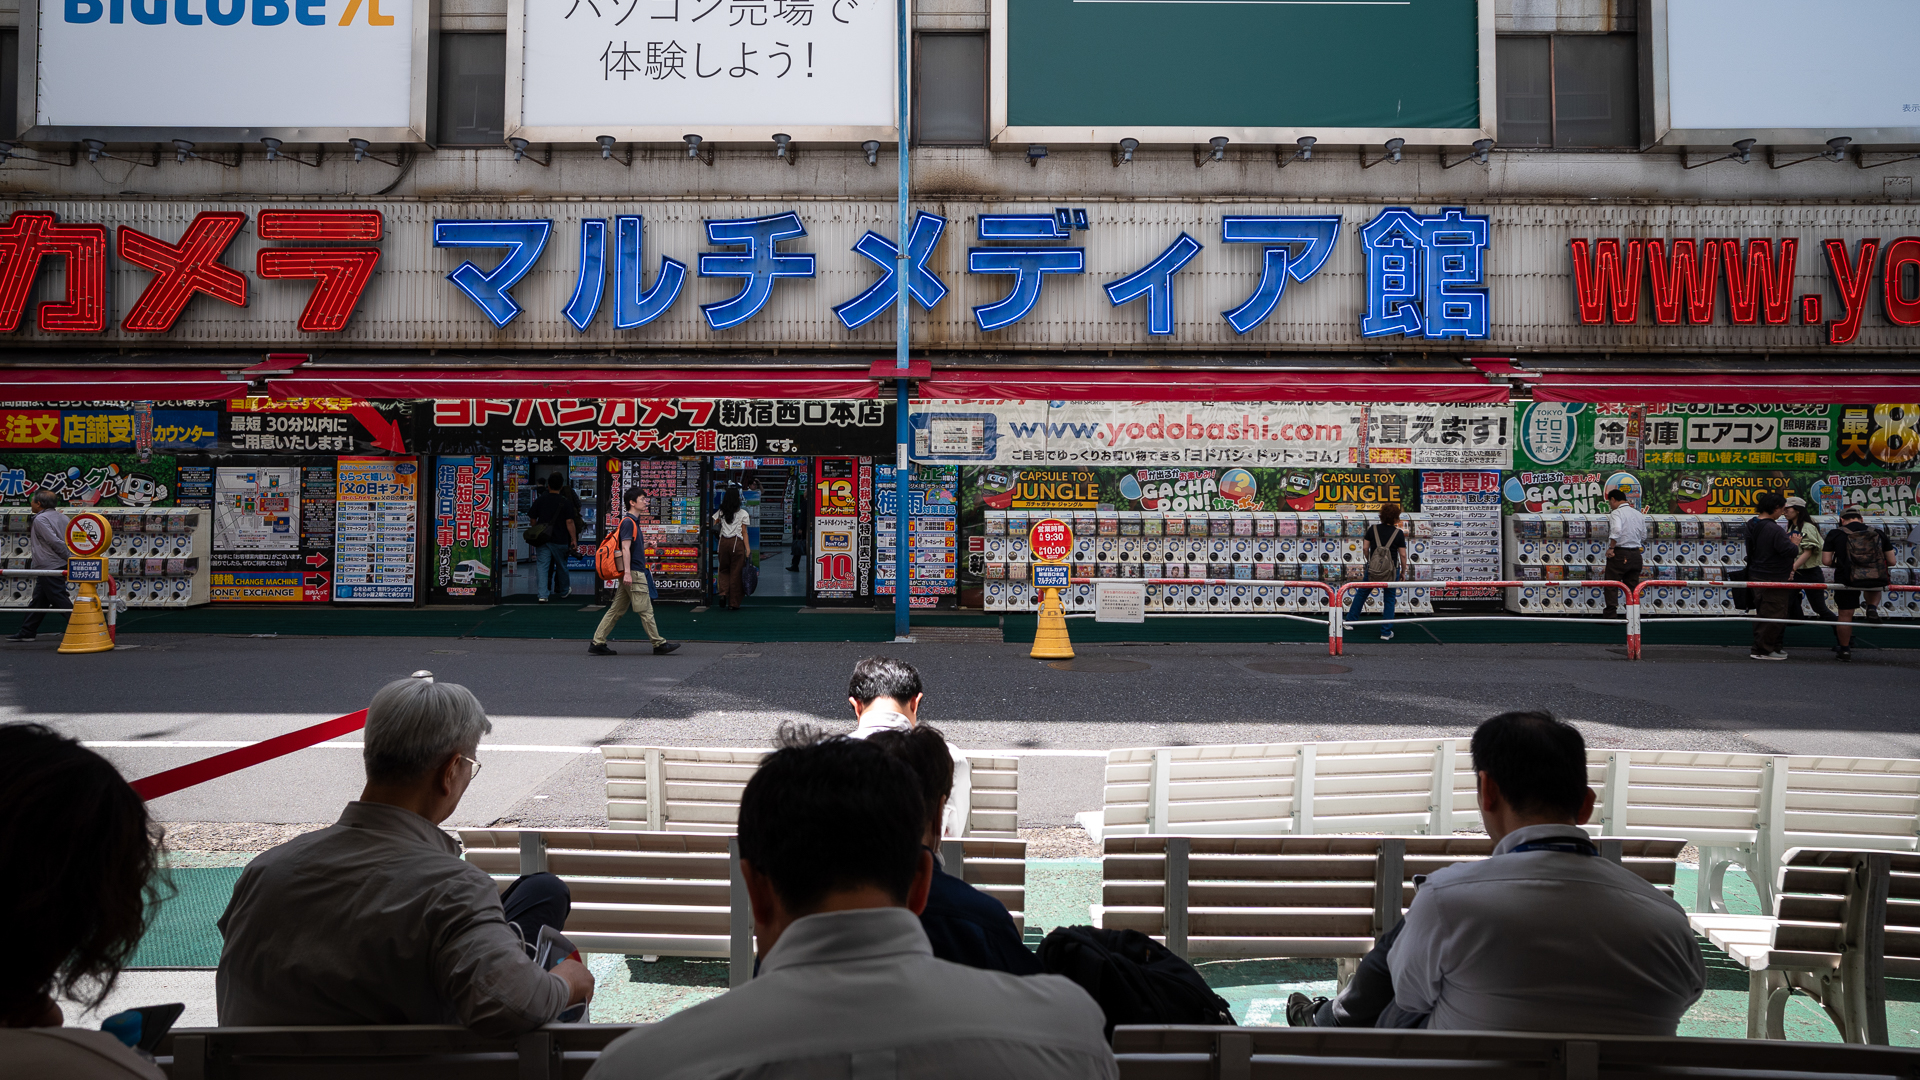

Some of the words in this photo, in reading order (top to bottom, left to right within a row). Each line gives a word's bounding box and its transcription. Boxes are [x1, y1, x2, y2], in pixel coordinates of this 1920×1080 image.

[600, 40, 813, 81] 体験しよう!
[433, 206, 1491, 342] マルチメディア館
[433, 398, 717, 427] ヨドバシカメラ
[719, 399, 885, 428] 新宿西口本店
[5, 414, 59, 444] 注文
[63, 414, 215, 444] 店舗受カウンター
[231, 416, 262, 431] 最短
[266, 416, 348, 432] 30分以内に
[1008, 414, 1342, 447] www.yodobashi.com
[1535, 418, 1562, 431] ゼロ
[1783, 420, 1828, 431] 照明器具
[1535, 432, 1562, 444] エミ
[1690, 422, 1775, 445] エアコン
[1841, 408, 1869, 460] 最大
[231, 435, 355, 451] ご用意いたします!
[501, 438, 554, 453] こちらは
[766, 438, 798, 453] です。
[1788, 437, 1821, 448] 給湯器
[608, 462, 619, 473] N
[919, 467, 945, 481] カビ
[339, 472, 395, 482] もらって嬉しい
[1019, 471, 1068, 482] CAPSULE
[1070, 471, 1095, 482] TOY
[1321, 473, 1370, 483] CAPSULE
[1374, 473, 1396, 483] TOY
[1421, 471, 1500, 493] 高額買取
[1714, 477, 1763, 487] CAPSULE
[1766, 477, 1791, 487] TOY
[339, 482, 414, 495] 「父の日ギフト」
[817, 479, 857, 507] 13%
[1012, 483, 1099, 500] JUNGLE
[1141, 478, 1218, 500] GACHA
[1314, 485, 1401, 502] JUNGLE
[1526, 482, 1602, 500] GACHA
[611, 473, 620, 526] マルチメディア館
[1468, 494, 1500, 503] 致します
[1037, 525, 1065, 533] 営業時間
[1045, 533, 1064, 541] 9:30
[1043, 546, 1066, 555] 10:00
[816, 553, 855, 581] 10%
[235, 578, 264, 586] CHANGE
[265, 578, 298, 586] MACHINE
[243, 589, 295, 597] EXCHANGE
